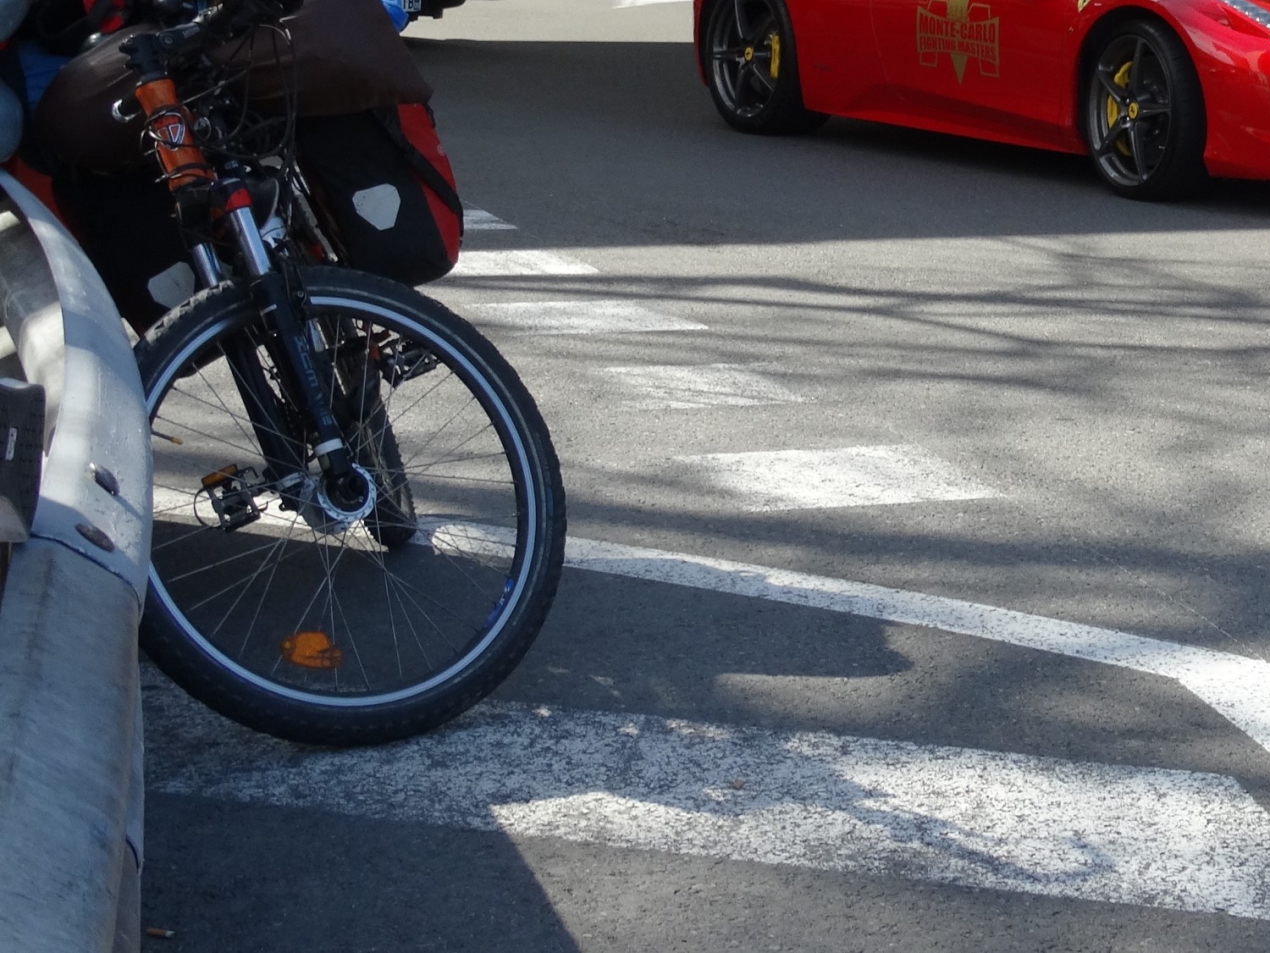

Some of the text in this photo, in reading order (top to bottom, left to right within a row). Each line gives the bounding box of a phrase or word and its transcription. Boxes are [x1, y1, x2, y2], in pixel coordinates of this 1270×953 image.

[919, 12, 996, 44] MONTE-CARLO
[919, 36, 996, 61] FIGHTING MASTERS
